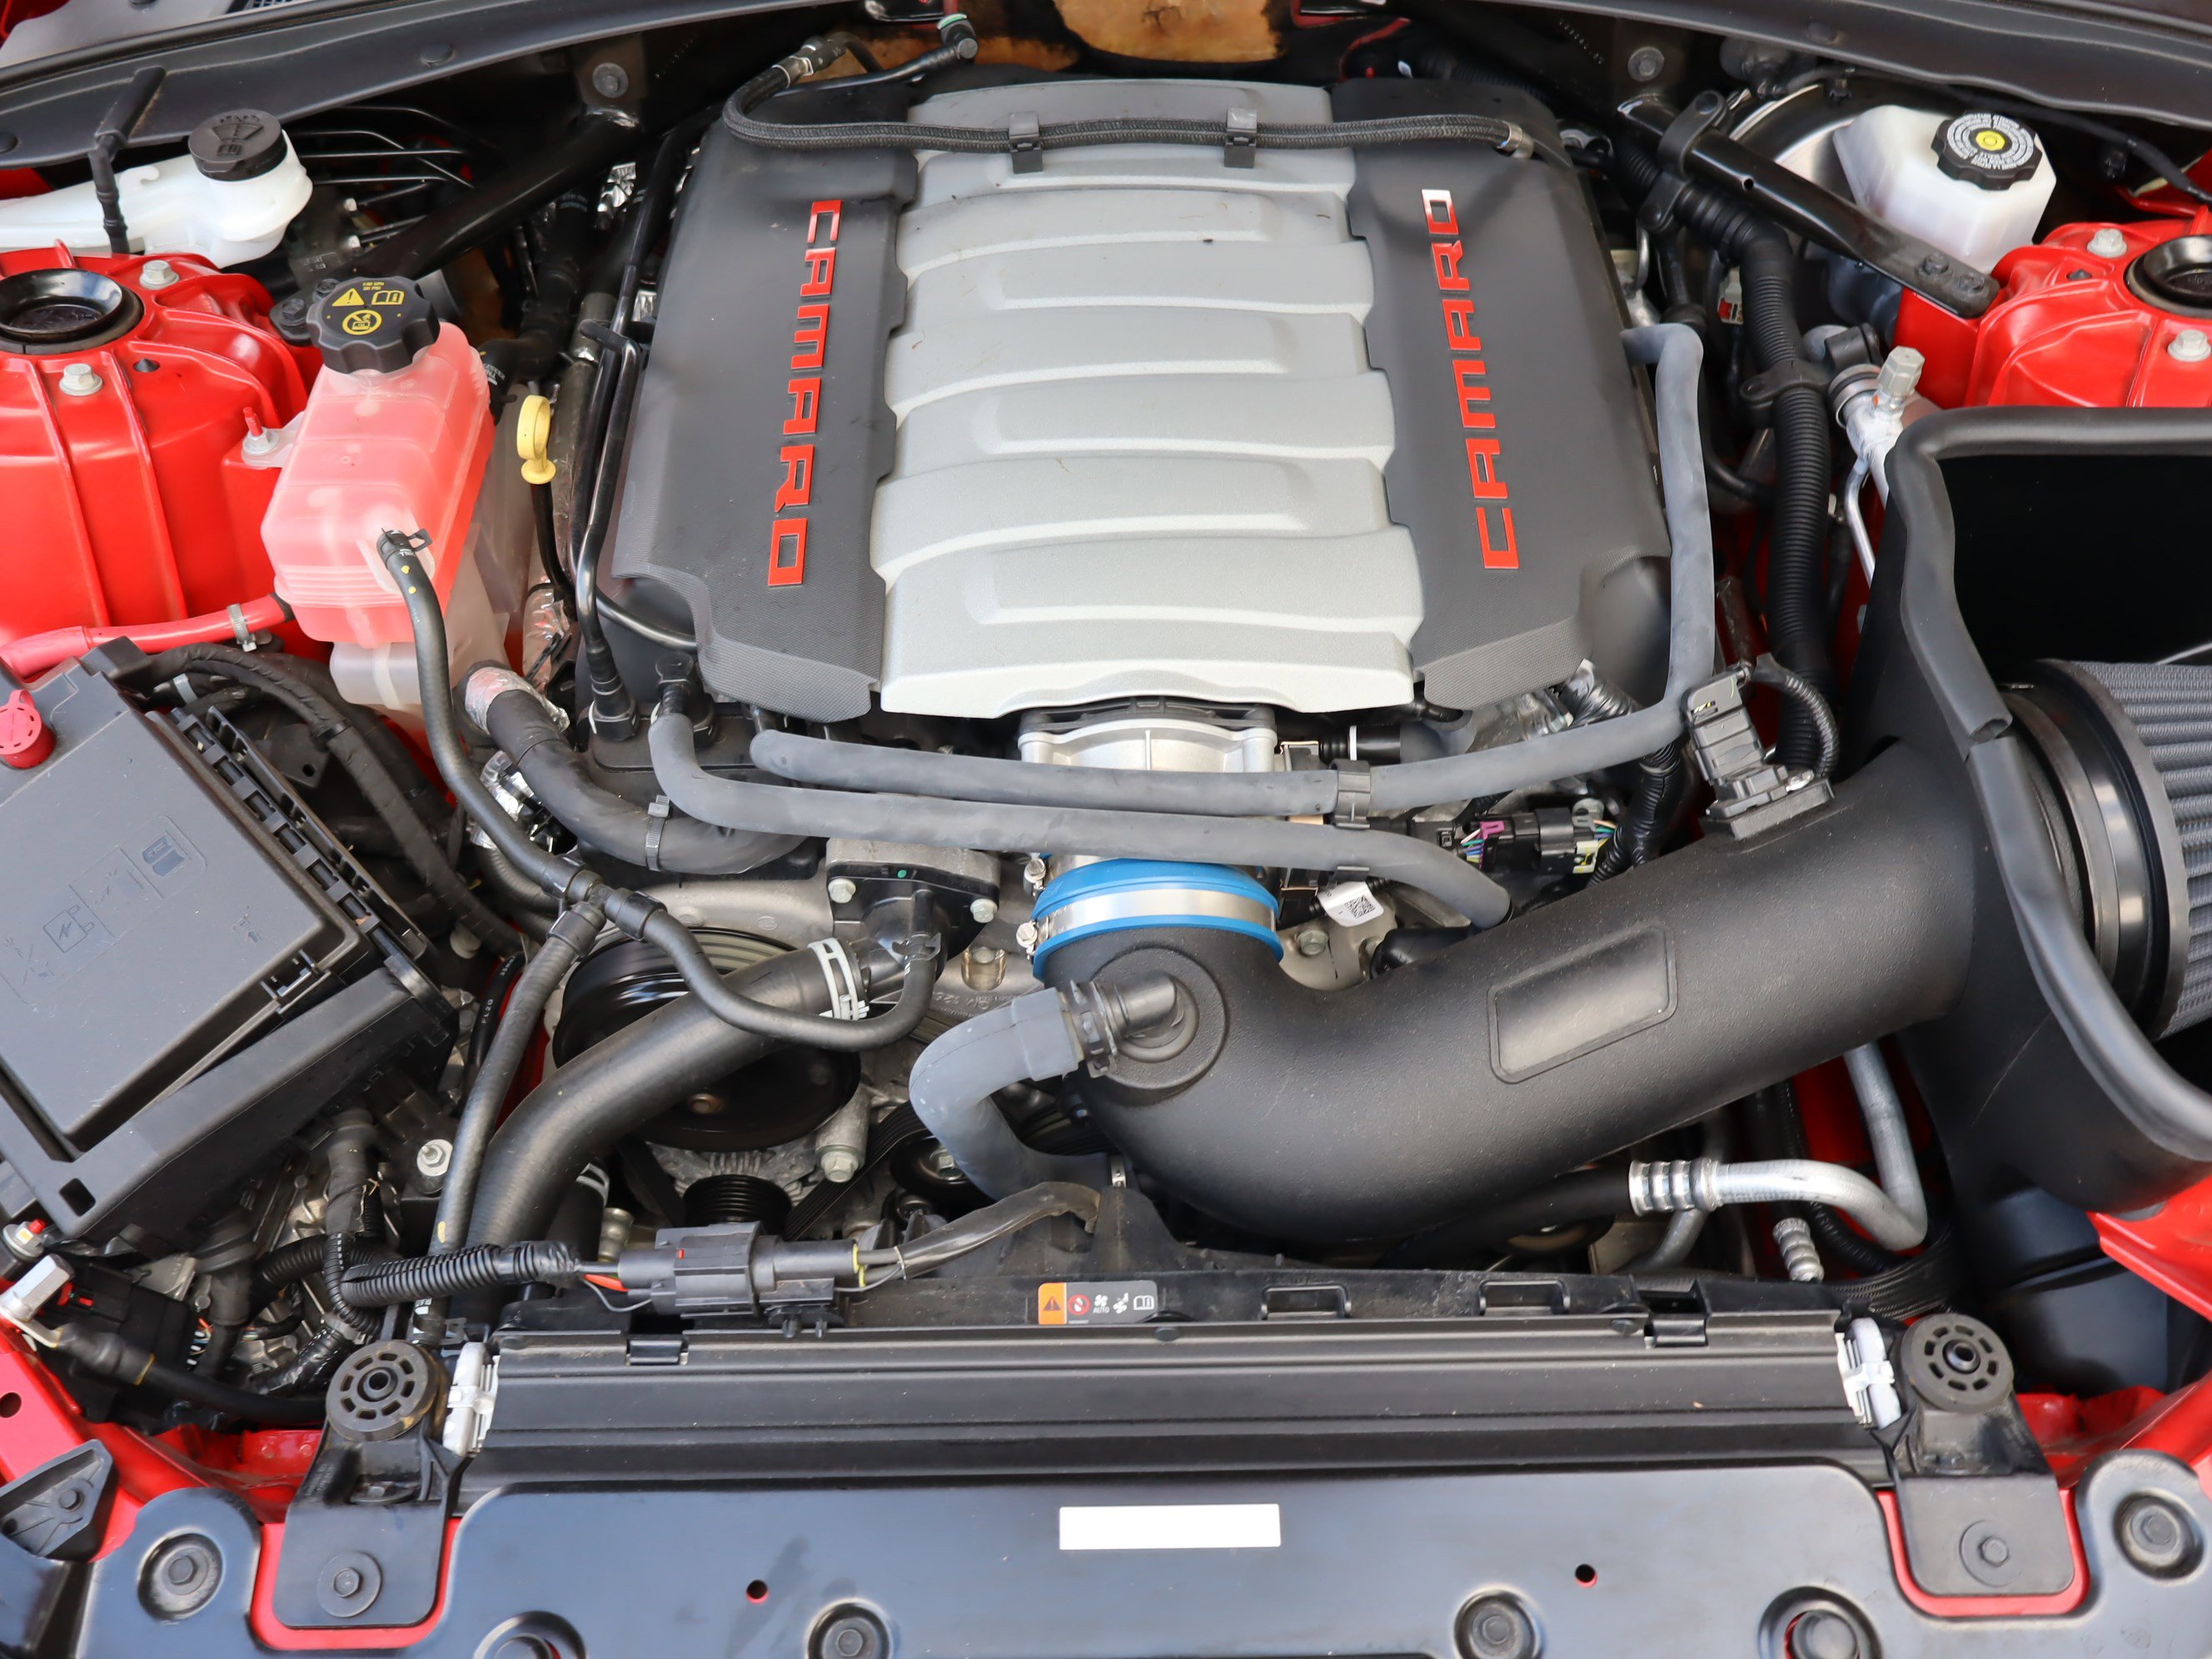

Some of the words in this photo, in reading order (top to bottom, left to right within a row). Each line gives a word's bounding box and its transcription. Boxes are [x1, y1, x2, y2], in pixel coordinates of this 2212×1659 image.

[767, 200, 842, 586] CAMARO
[1422, 189, 1519, 569] CAMARO
[1093, 1306, 1110, 1314] AUTO
